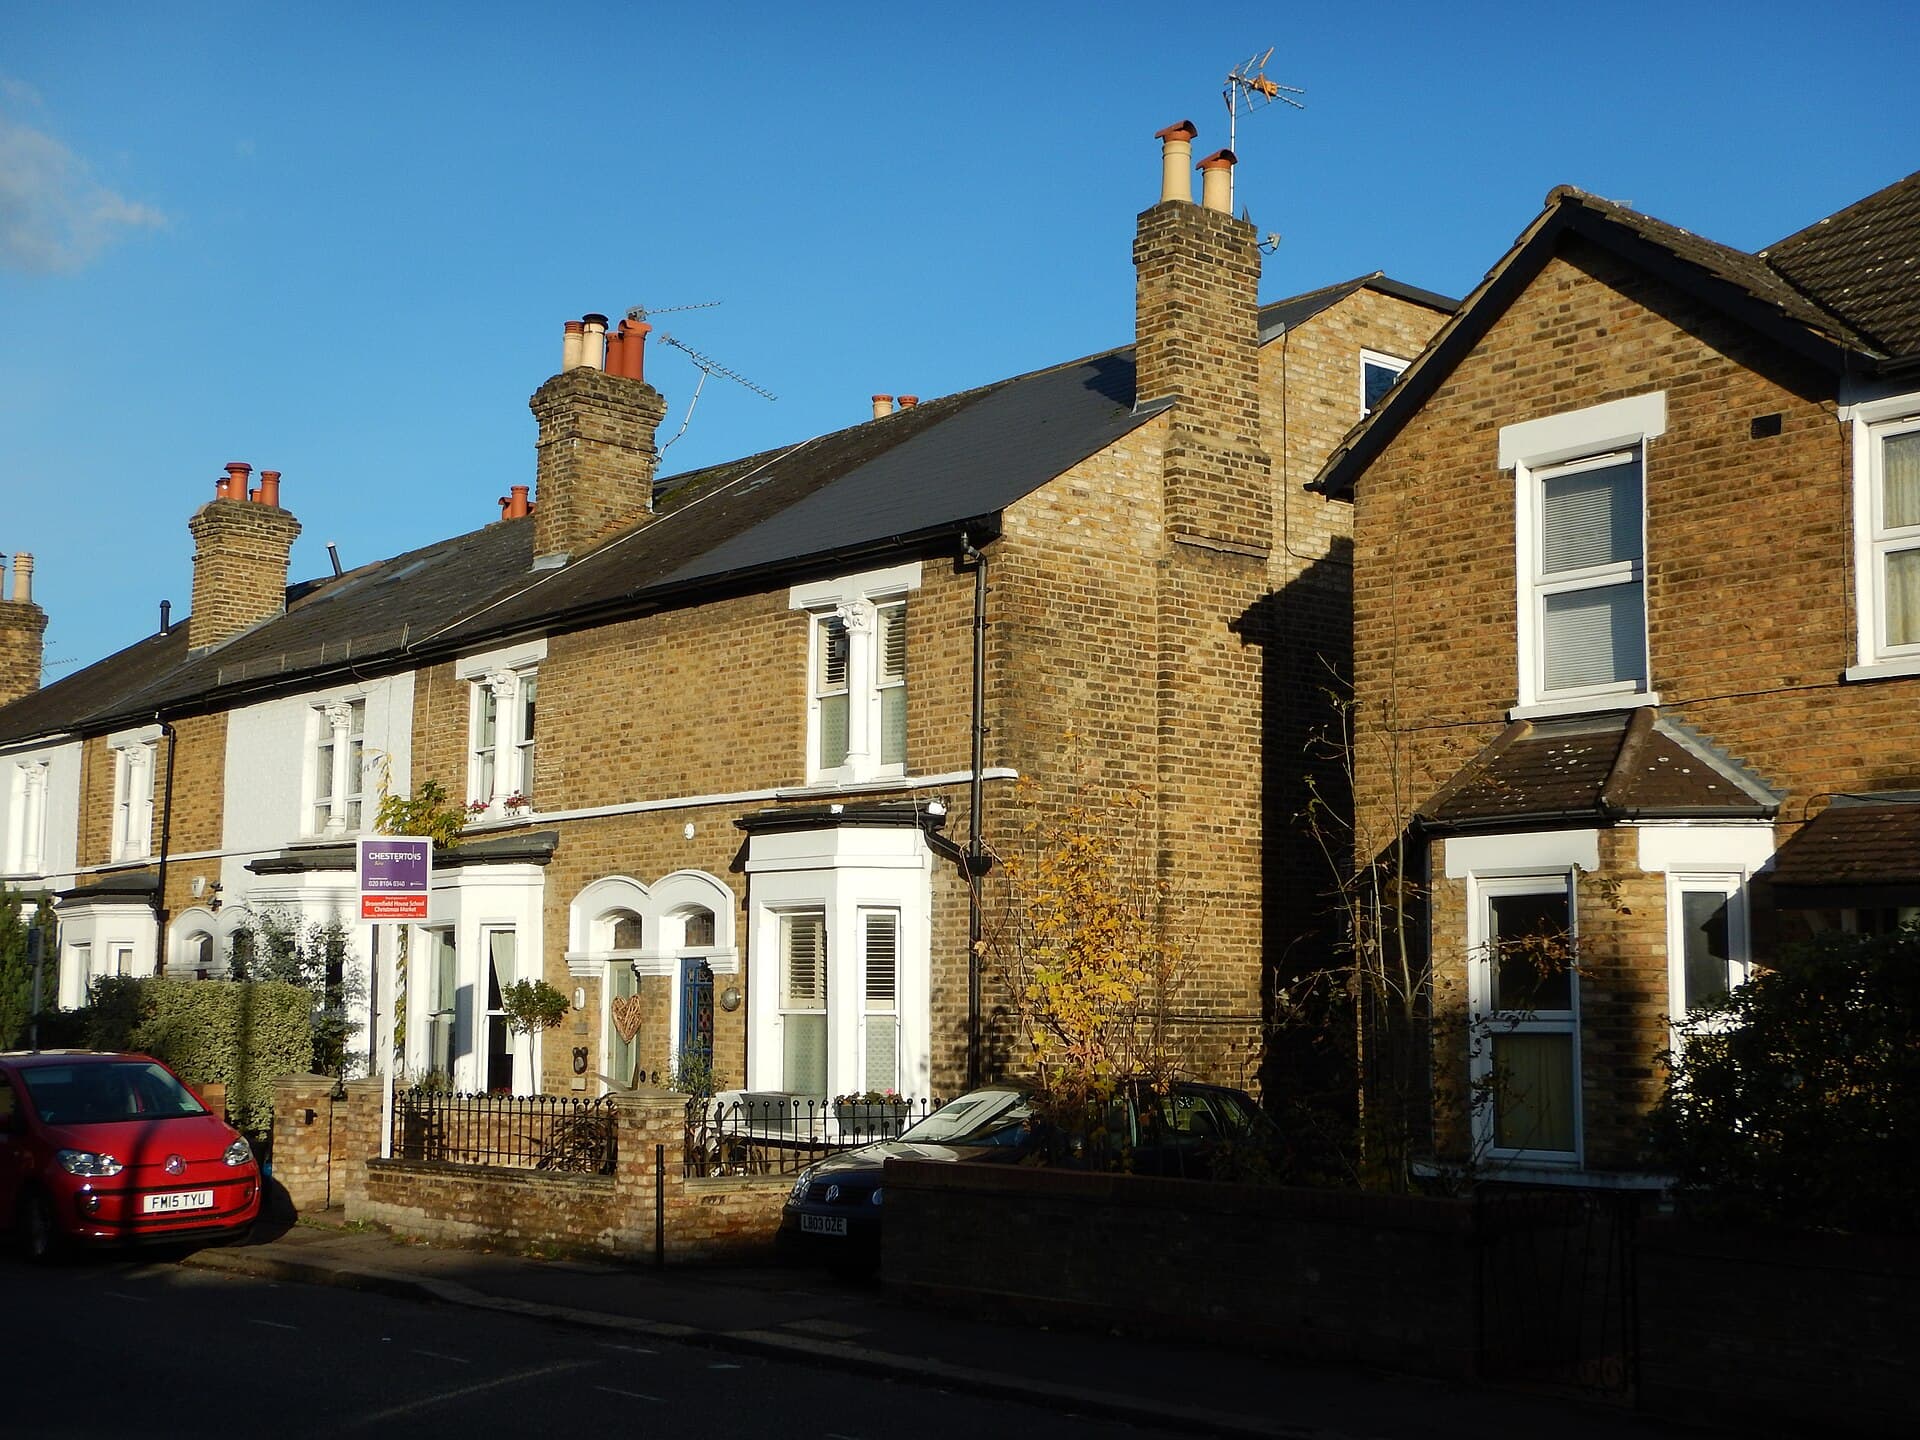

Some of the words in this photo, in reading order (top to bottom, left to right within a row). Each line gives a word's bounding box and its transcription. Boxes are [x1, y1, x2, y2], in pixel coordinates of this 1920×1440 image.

[368, 852, 422, 861] CHESTERTONS
[152, 1195, 179, 1209] FM15
[183, 1193, 206, 1207] TYU
